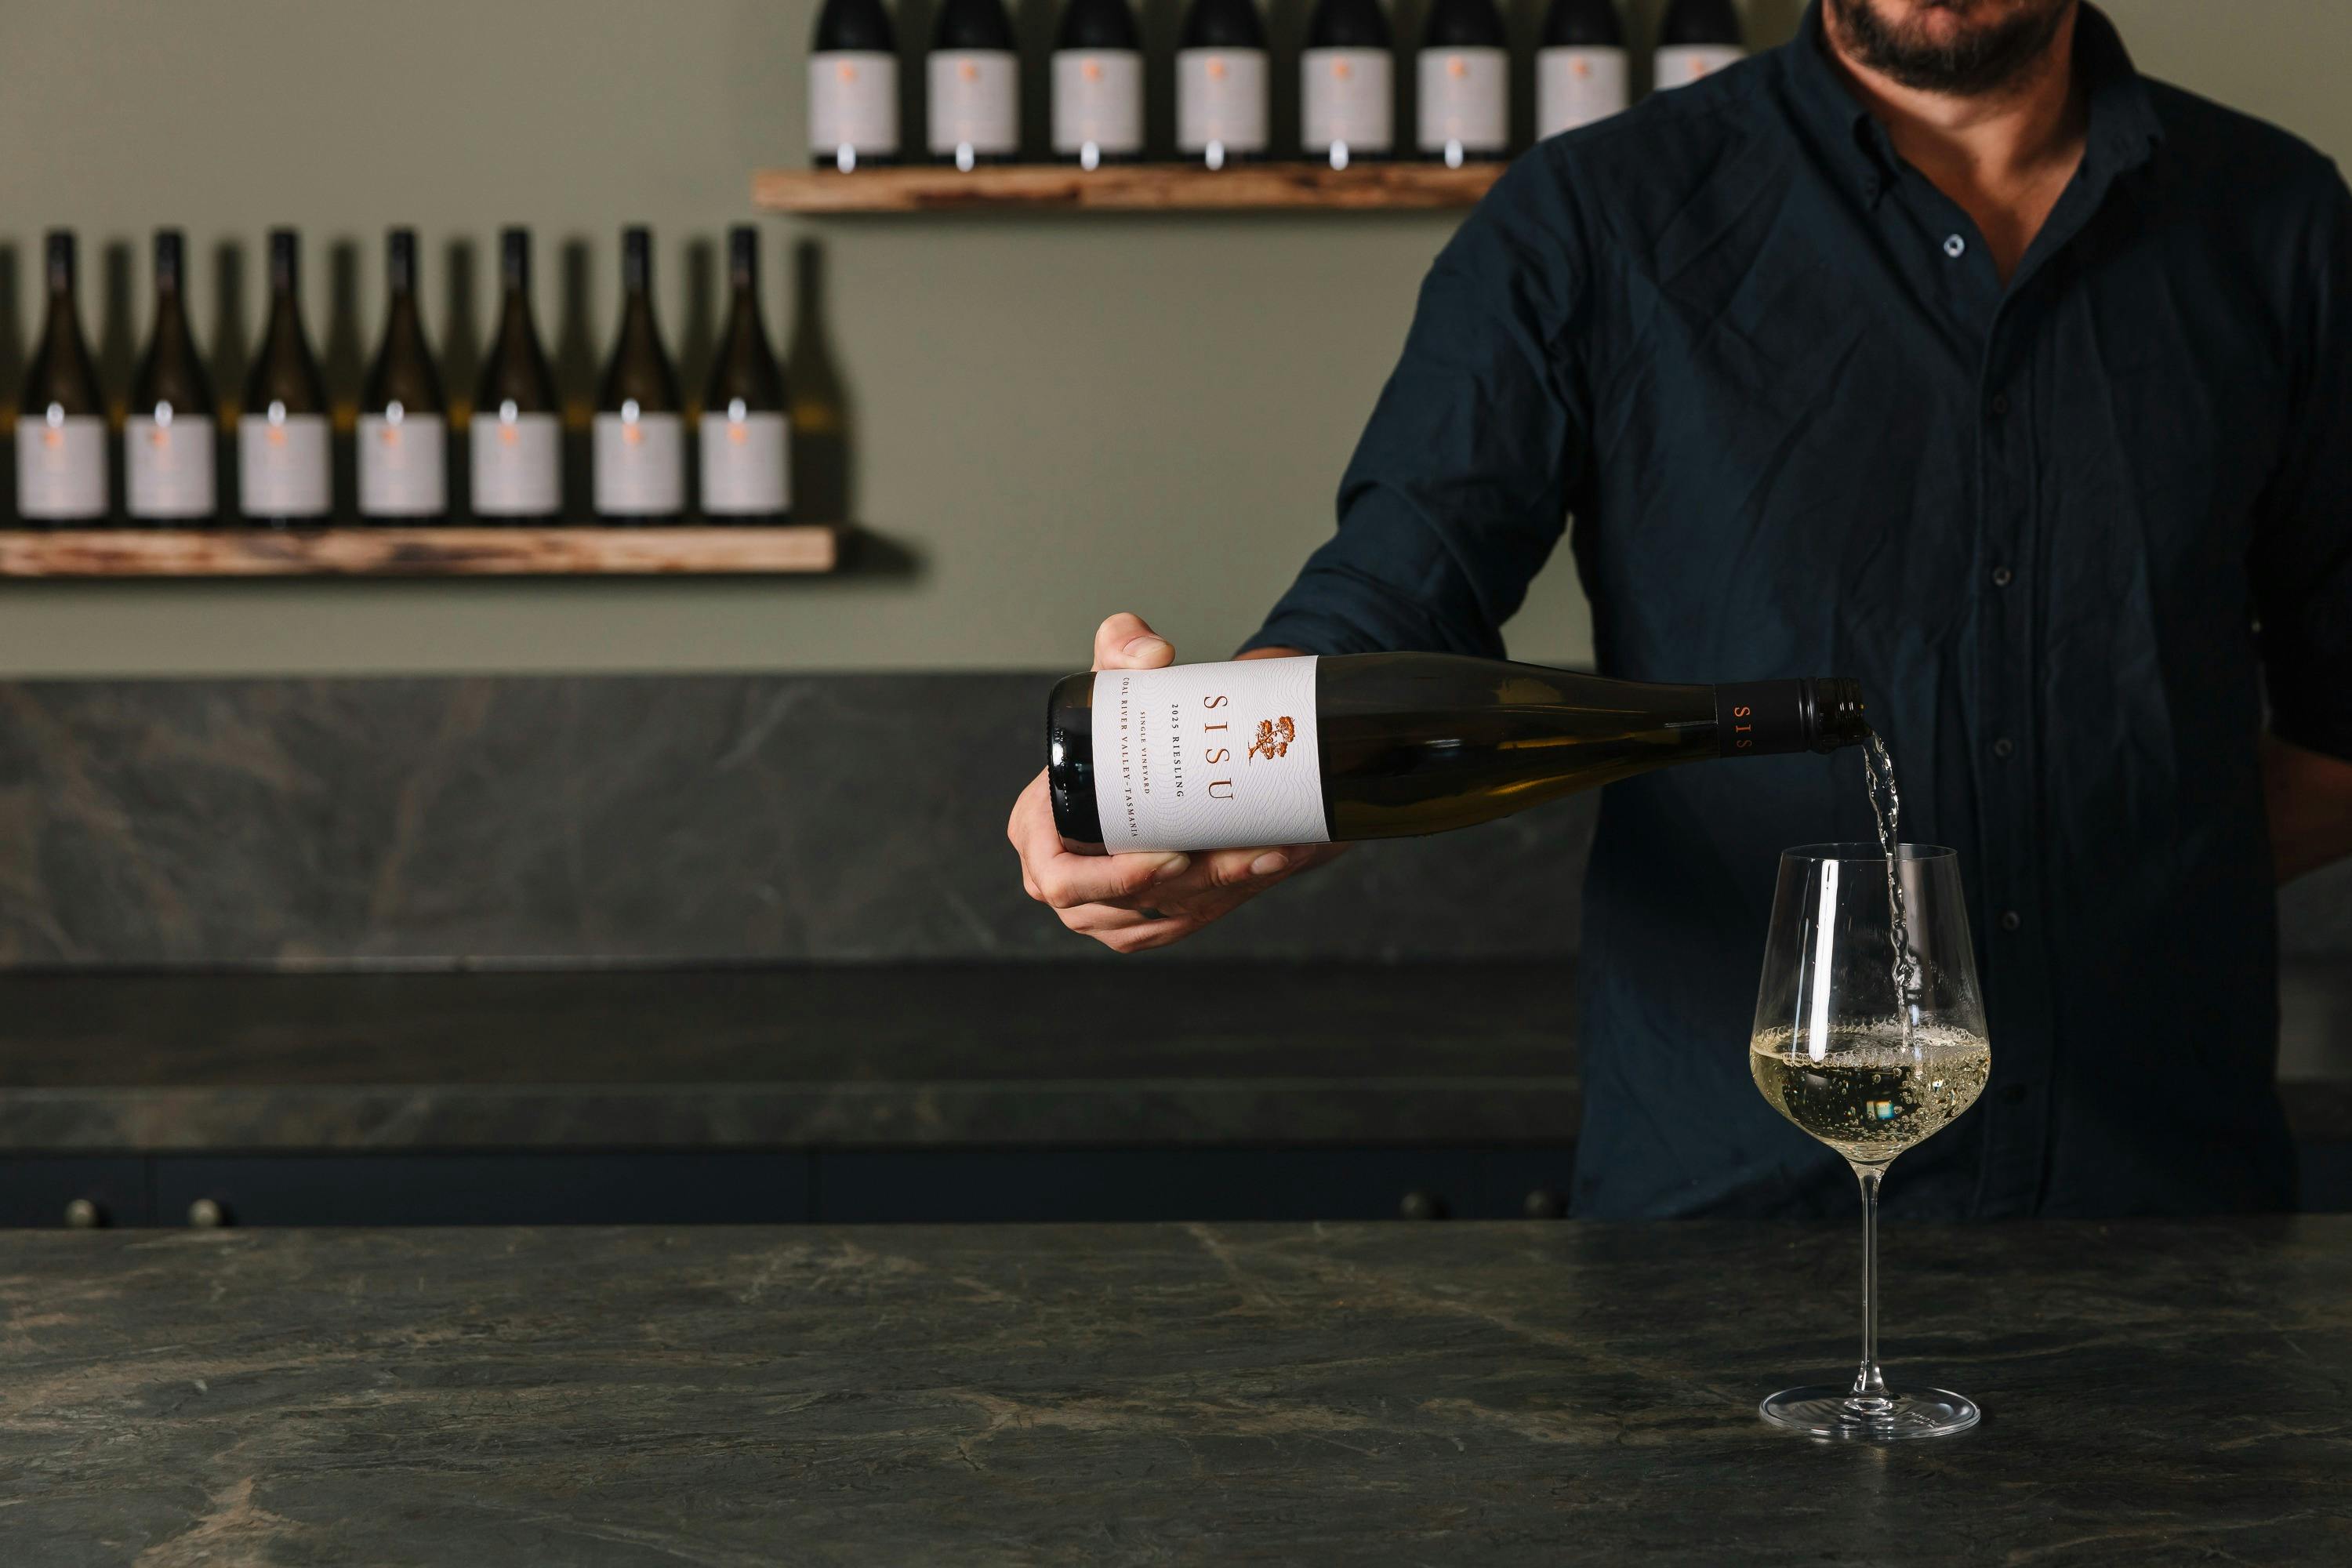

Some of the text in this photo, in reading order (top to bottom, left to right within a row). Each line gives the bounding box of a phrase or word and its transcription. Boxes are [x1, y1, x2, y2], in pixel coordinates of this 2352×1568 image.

[1121, 677, 1130, 696] COAL
[1203, 695, 1234, 800] SISU
[1734, 706, 1752, 748] SIS
[1141, 747, 1150, 794] VINEYARD
[1172, 736, 1184, 797] RIESLING
